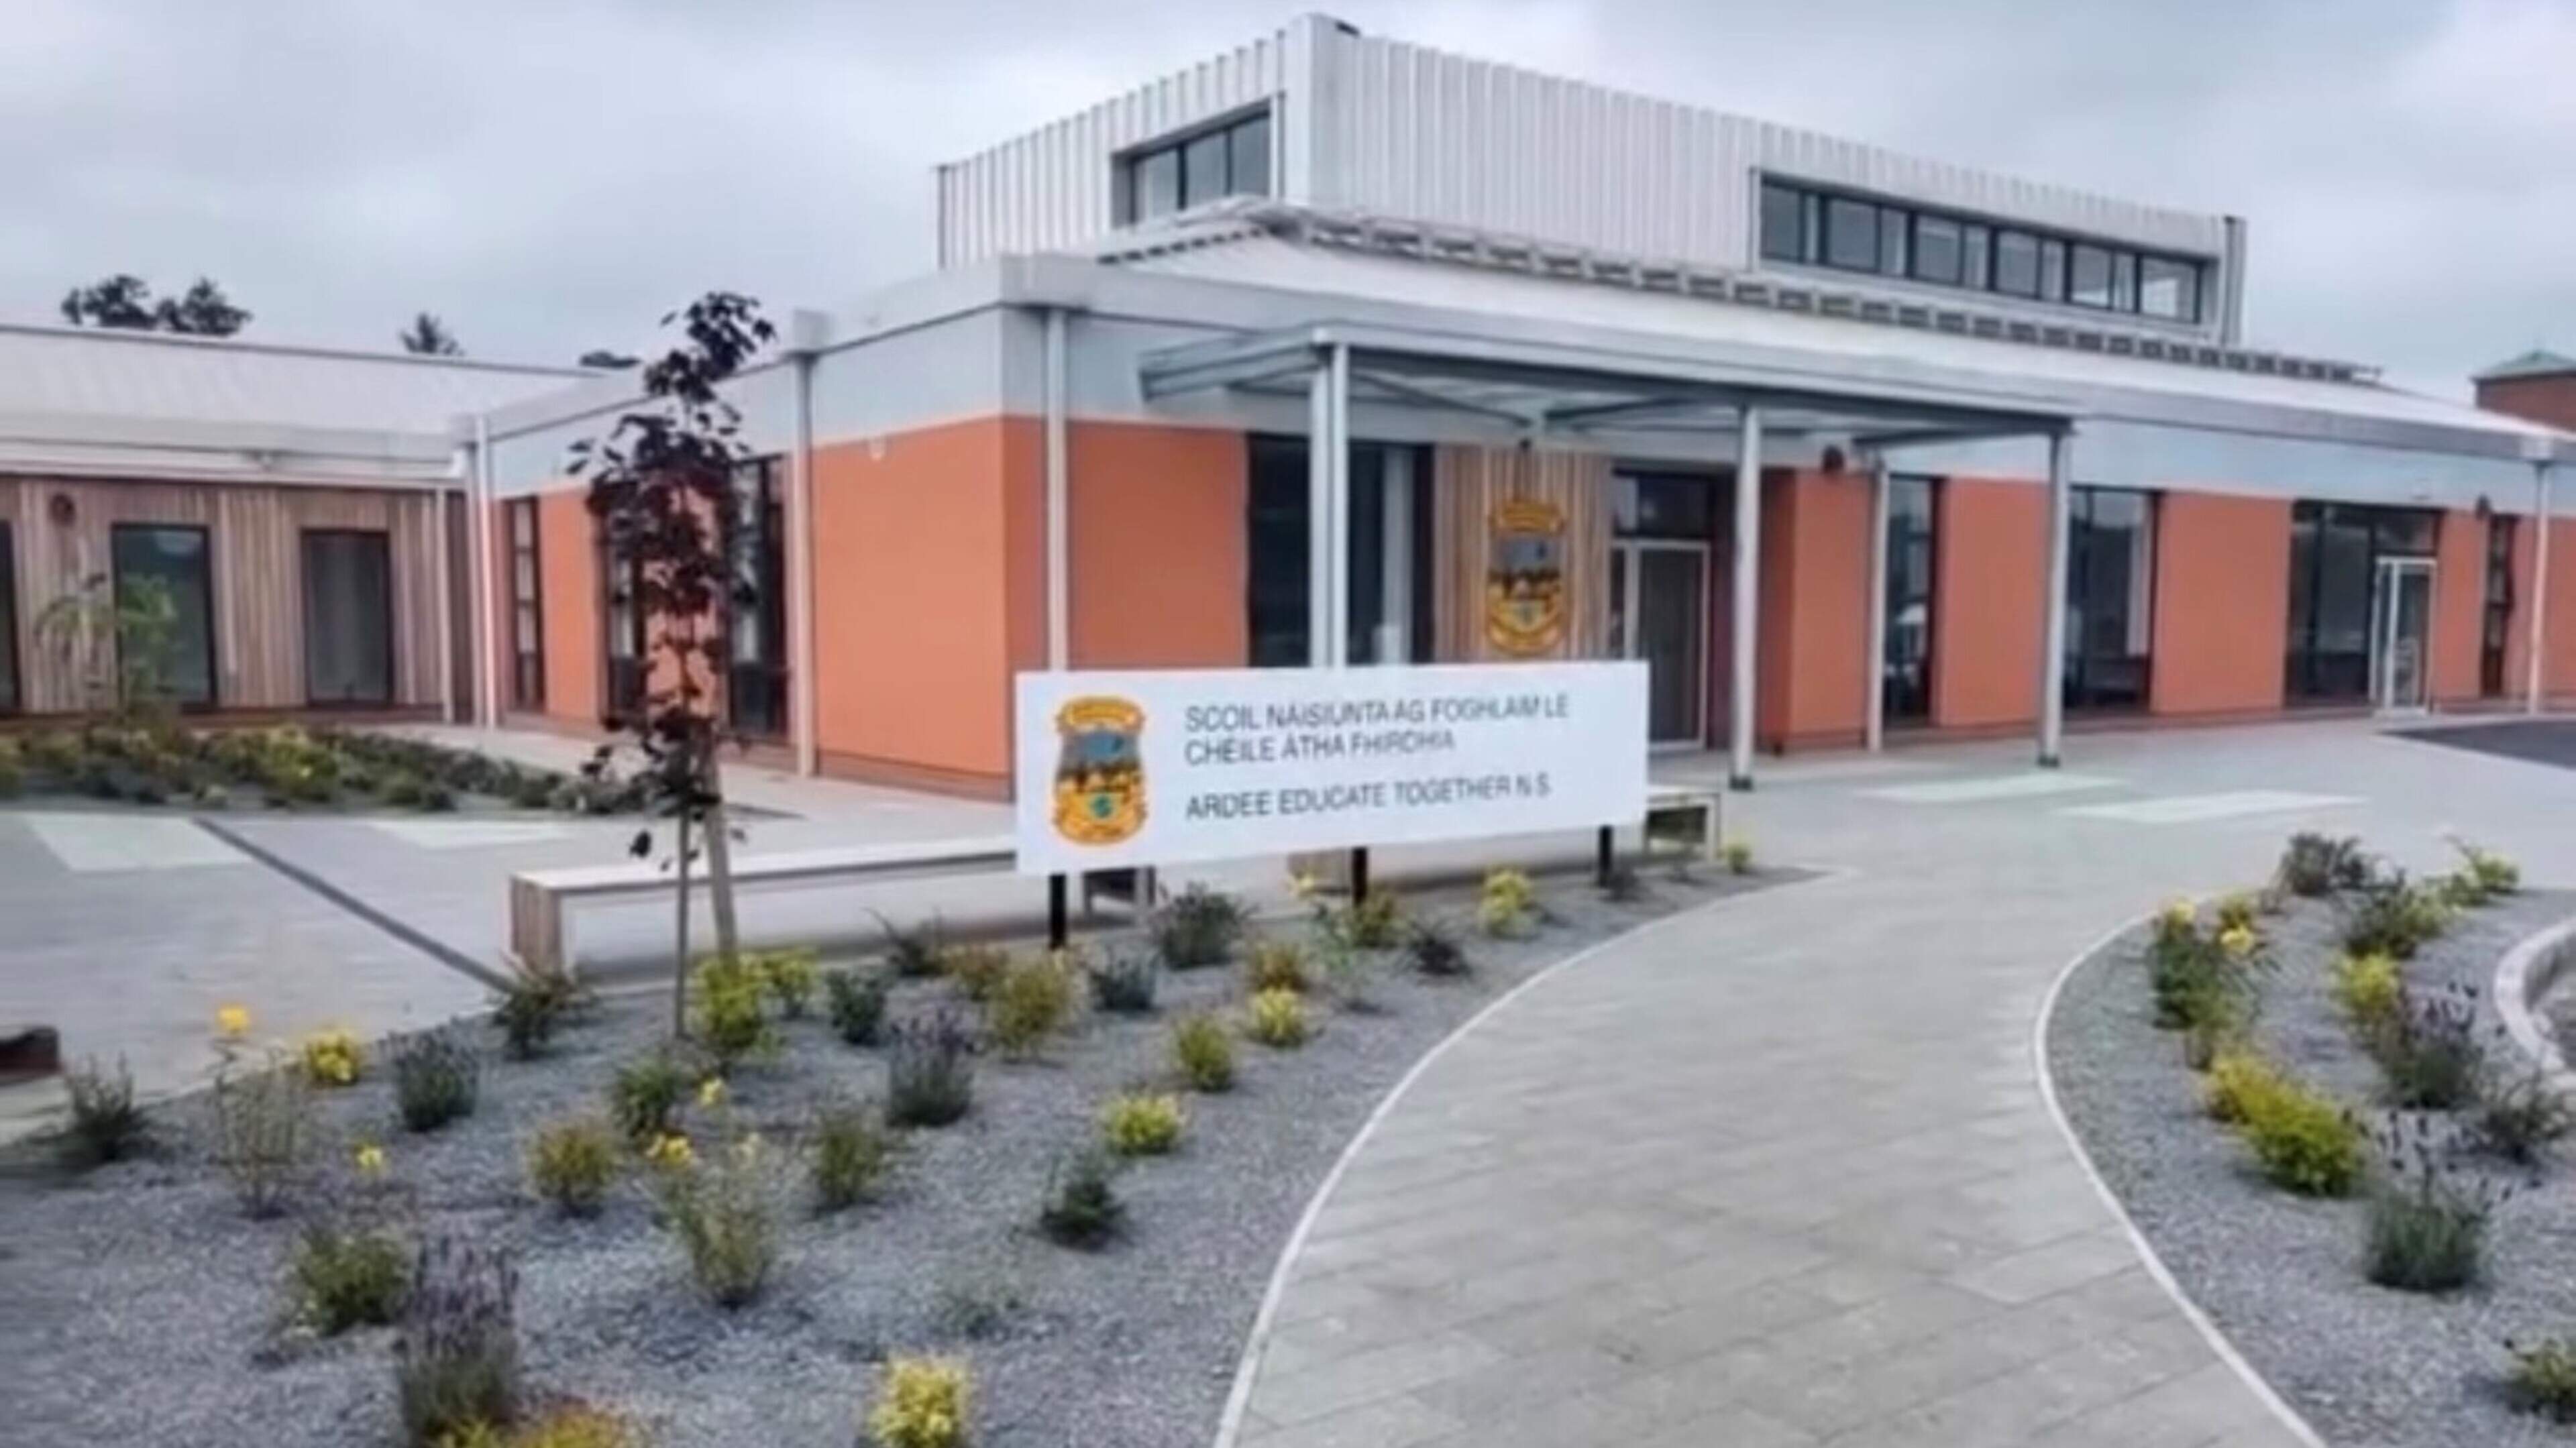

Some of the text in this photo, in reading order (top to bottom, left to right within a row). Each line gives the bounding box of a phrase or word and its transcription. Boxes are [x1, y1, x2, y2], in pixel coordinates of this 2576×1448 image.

[1185, 705, 1262, 732] SCOIL
[1394, 699, 1425, 722] AG
[1544, 693, 1566, 718] LE
[1186, 791, 1271, 820] ARDEE
[1278, 783, 1385, 814] EDUCATE
[1394, 775, 1509, 805] TOGETHER
